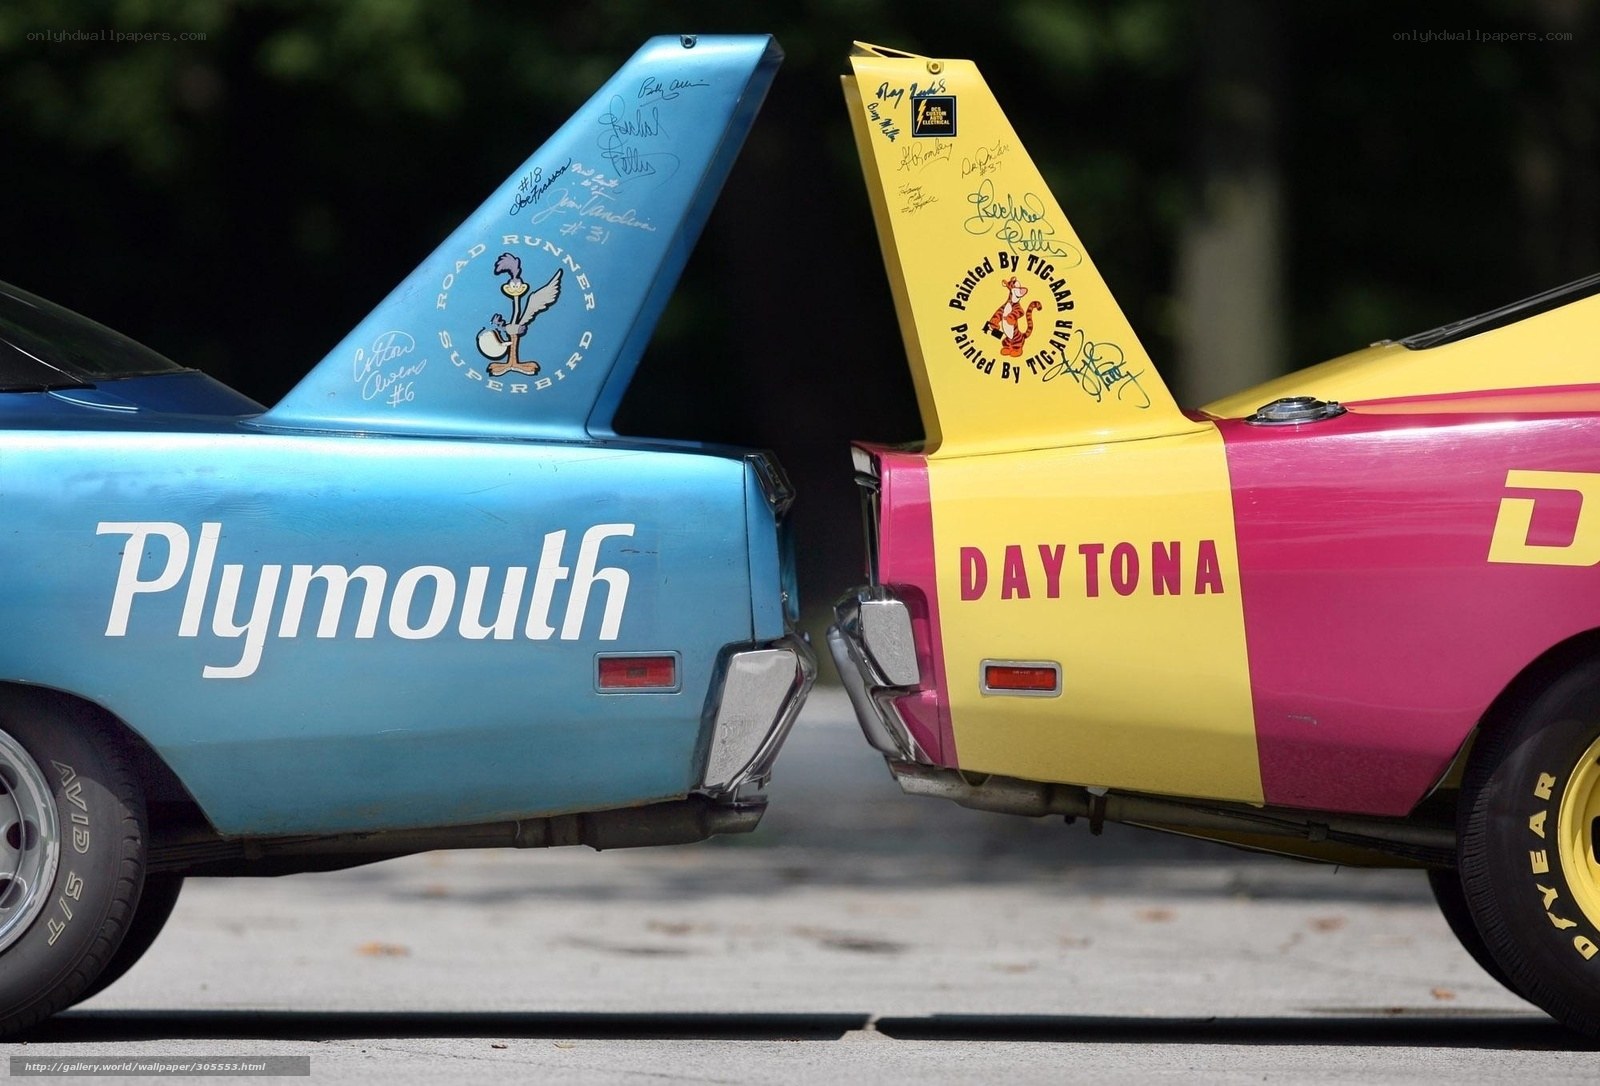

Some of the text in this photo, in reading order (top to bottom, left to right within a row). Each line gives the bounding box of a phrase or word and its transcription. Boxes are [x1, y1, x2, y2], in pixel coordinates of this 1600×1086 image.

[518, 167, 542, 192] #18
[436, 234, 595, 311] ROAD RUNNER
[949, 257, 994, 311] Painted
[998, 251, 1019, 272] By
[438, 330, 593, 393] SUPERBIRD
[951, 323, 996, 375] Painted
[1001, 362, 1020, 383] By
[386, 381, 415, 408] #6
[96, 522, 635, 679] Plymouth
[960, 540, 1225, 602] DAYTONA
[48, 759, 90, 946] AVID S/T
